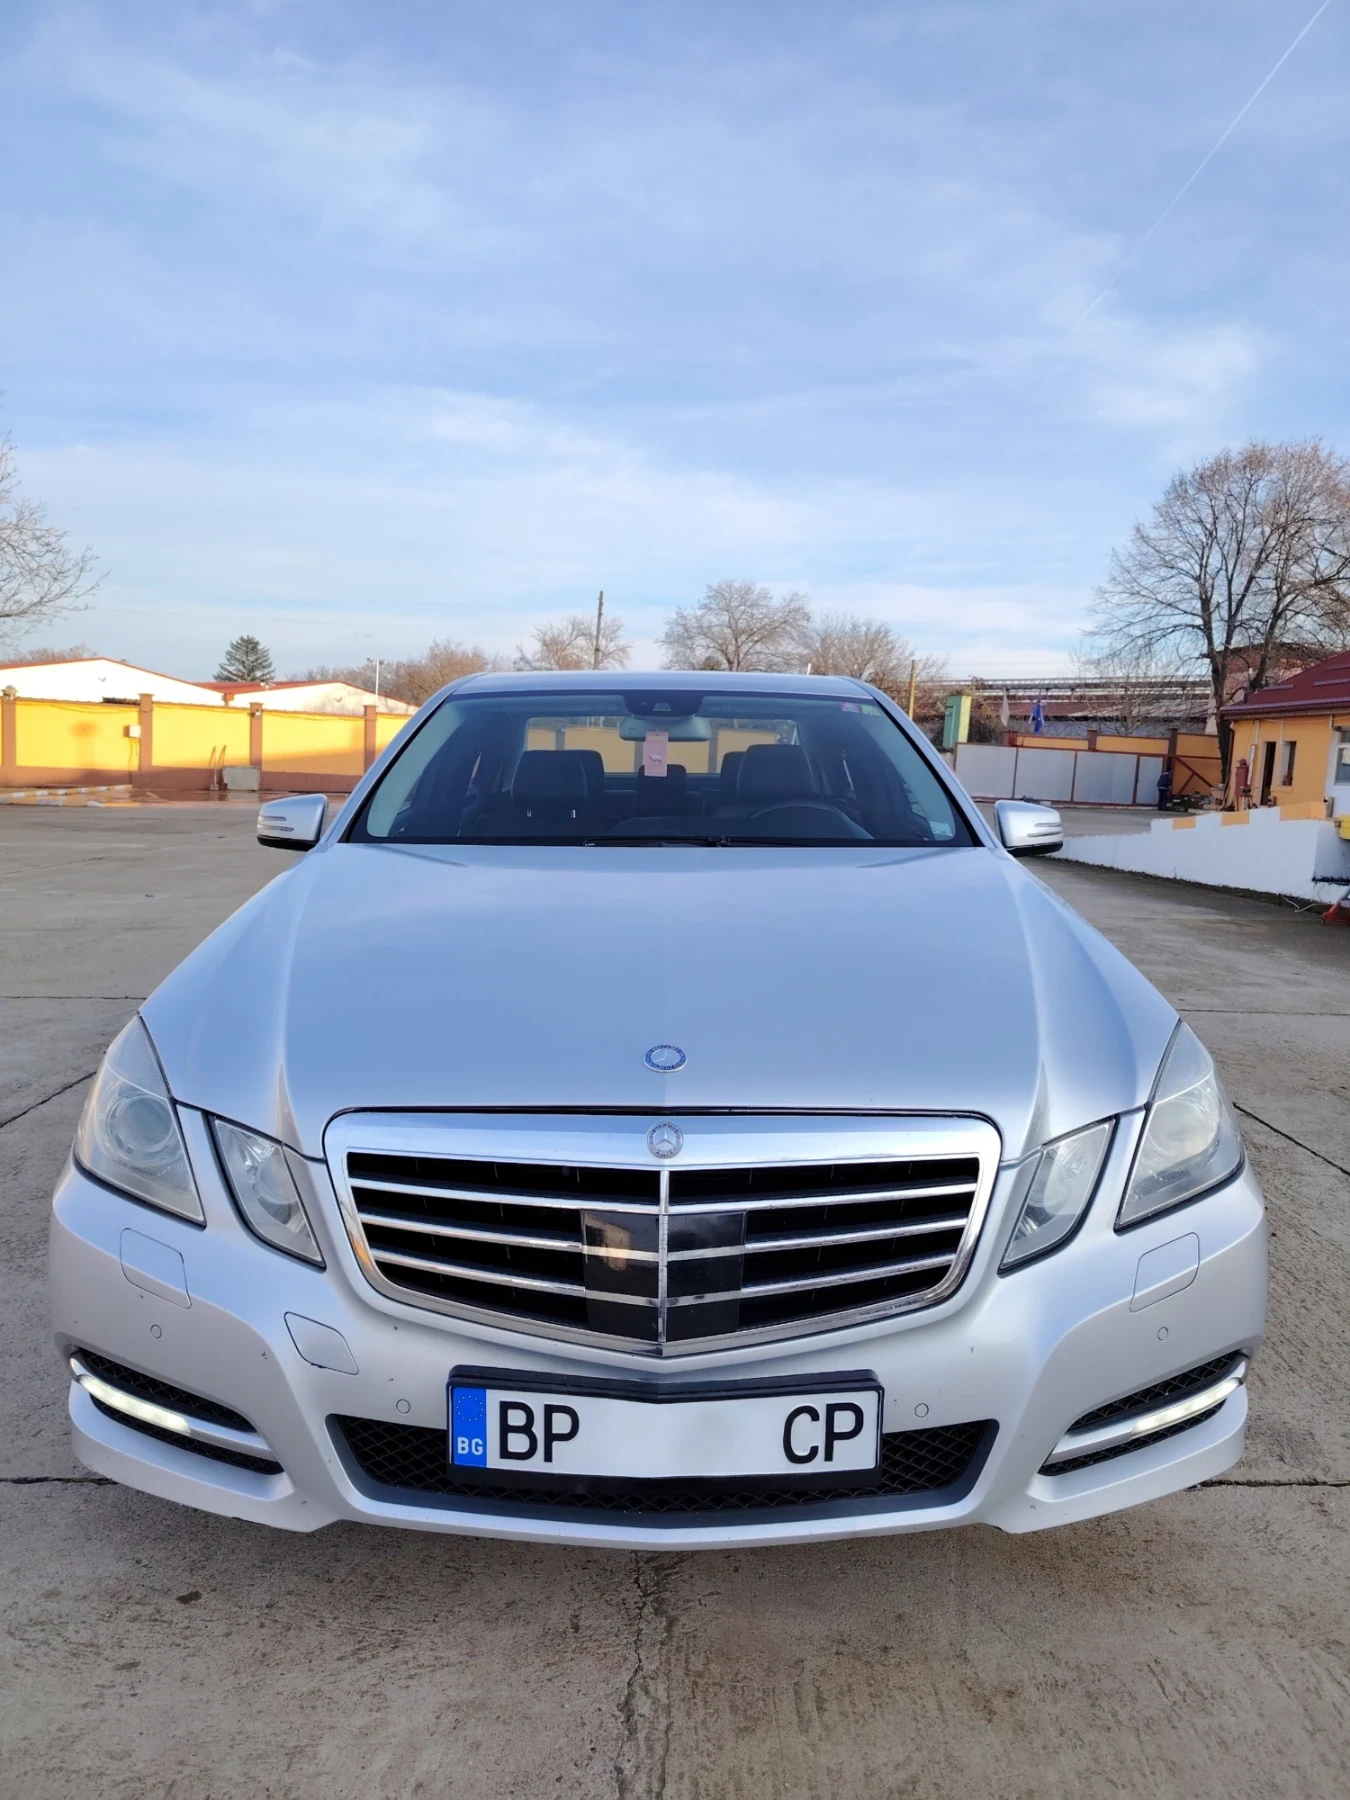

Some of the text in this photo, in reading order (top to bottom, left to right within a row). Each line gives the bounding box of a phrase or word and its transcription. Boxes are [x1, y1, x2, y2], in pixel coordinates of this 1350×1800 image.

[457, 1436, 484, 1456] BG
[499, 1401, 865, 1464] BP CP
